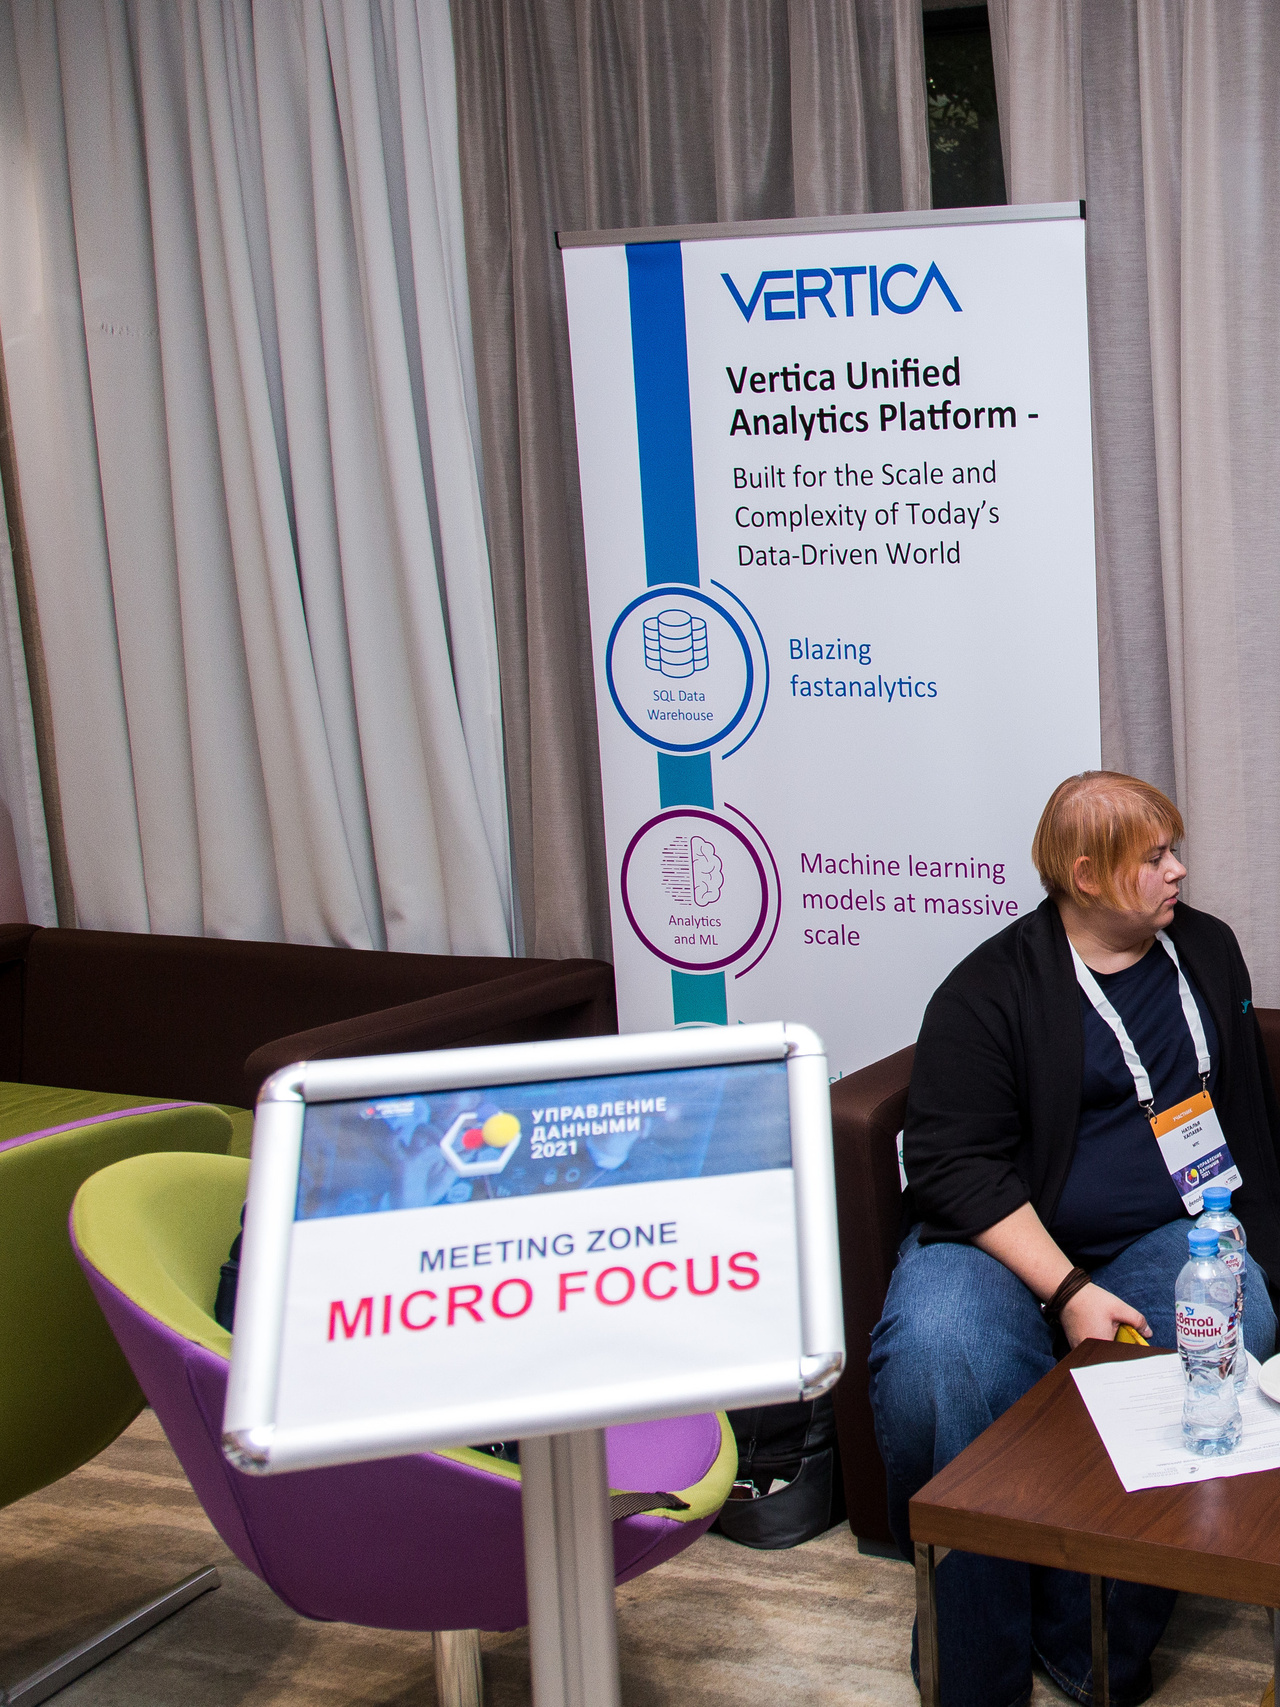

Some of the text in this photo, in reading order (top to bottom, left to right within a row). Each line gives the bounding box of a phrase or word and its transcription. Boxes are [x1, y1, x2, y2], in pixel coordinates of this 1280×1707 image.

[720, 261, 962, 323] VERTICA
[726, 356, 960, 393] Vertica Unified
[730, 405, 868, 441] Analytics
[880, 400, 1016, 431] Platform
[734, 460, 995, 488] Built for the Scale and
[736, 500, 999, 532] Complexity of Today’s
[739, 541, 960, 566] Data-Driven World
[790, 638, 871, 665] Blazing
[654, 690, 705, 702] SQL Data
[790, 674, 937, 702] fastanalytics
[647, 709, 713, 721] Warehouse
[801, 853, 1005, 884] Machine learning
[803, 889, 1018, 916] models at massive
[669, 915, 721, 929] Analytics
[804, 924, 859, 946] scale
[675, 934, 718, 945] and ML
[531, 1096, 667, 1124] УПРАВЛЕНИЕ
[530, 1116, 641, 1145] ДАННЫМИ
[530, 1139, 578, 1159] 2021
[420, 1222, 678, 1274] MEETING ZONE
[327, 1251, 761, 1342] MICRO FOCUS
